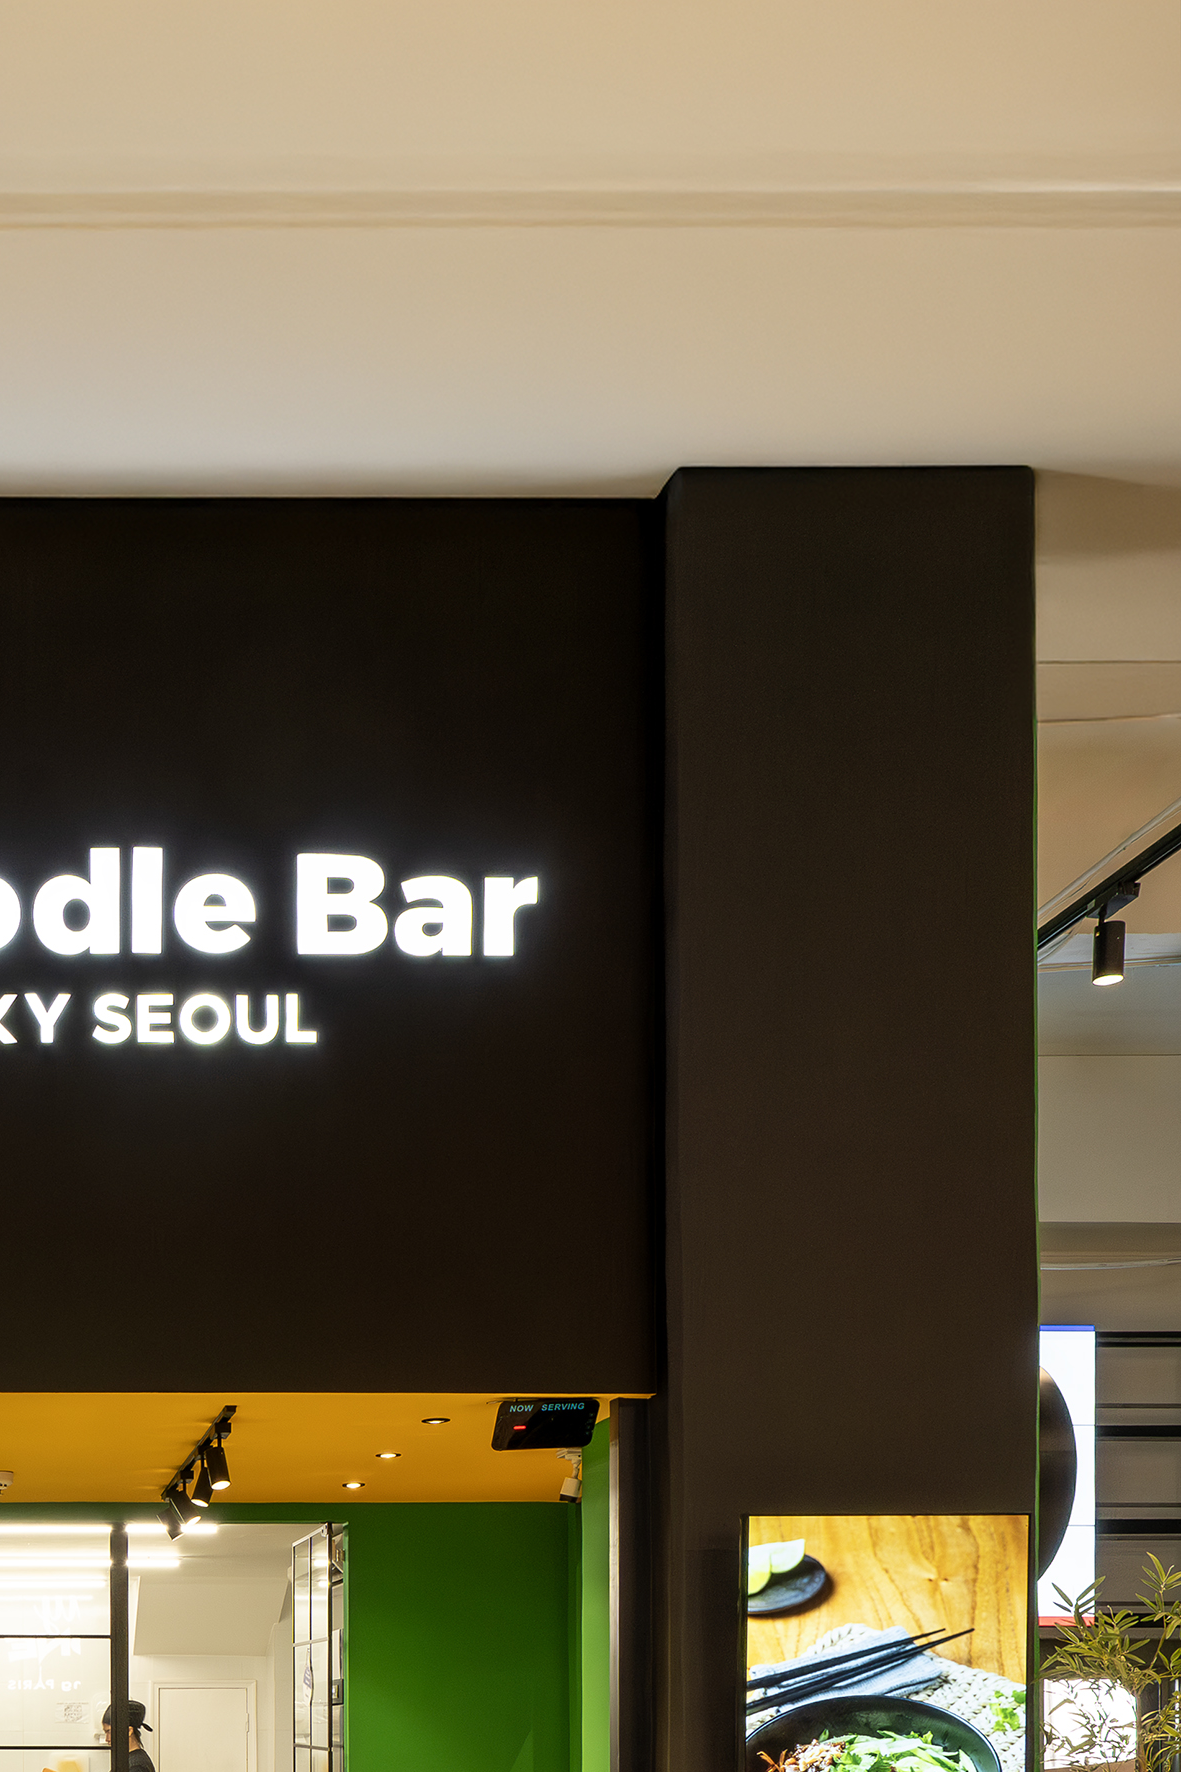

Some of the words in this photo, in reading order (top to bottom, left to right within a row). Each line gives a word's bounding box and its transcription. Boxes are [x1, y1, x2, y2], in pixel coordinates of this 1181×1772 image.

[296, 852, 540, 957] Bar
[92, 991, 318, 1046] SEOUL
[509, 1404, 534, 1413] NOW
[541, 1402, 585, 1412] SERVING
